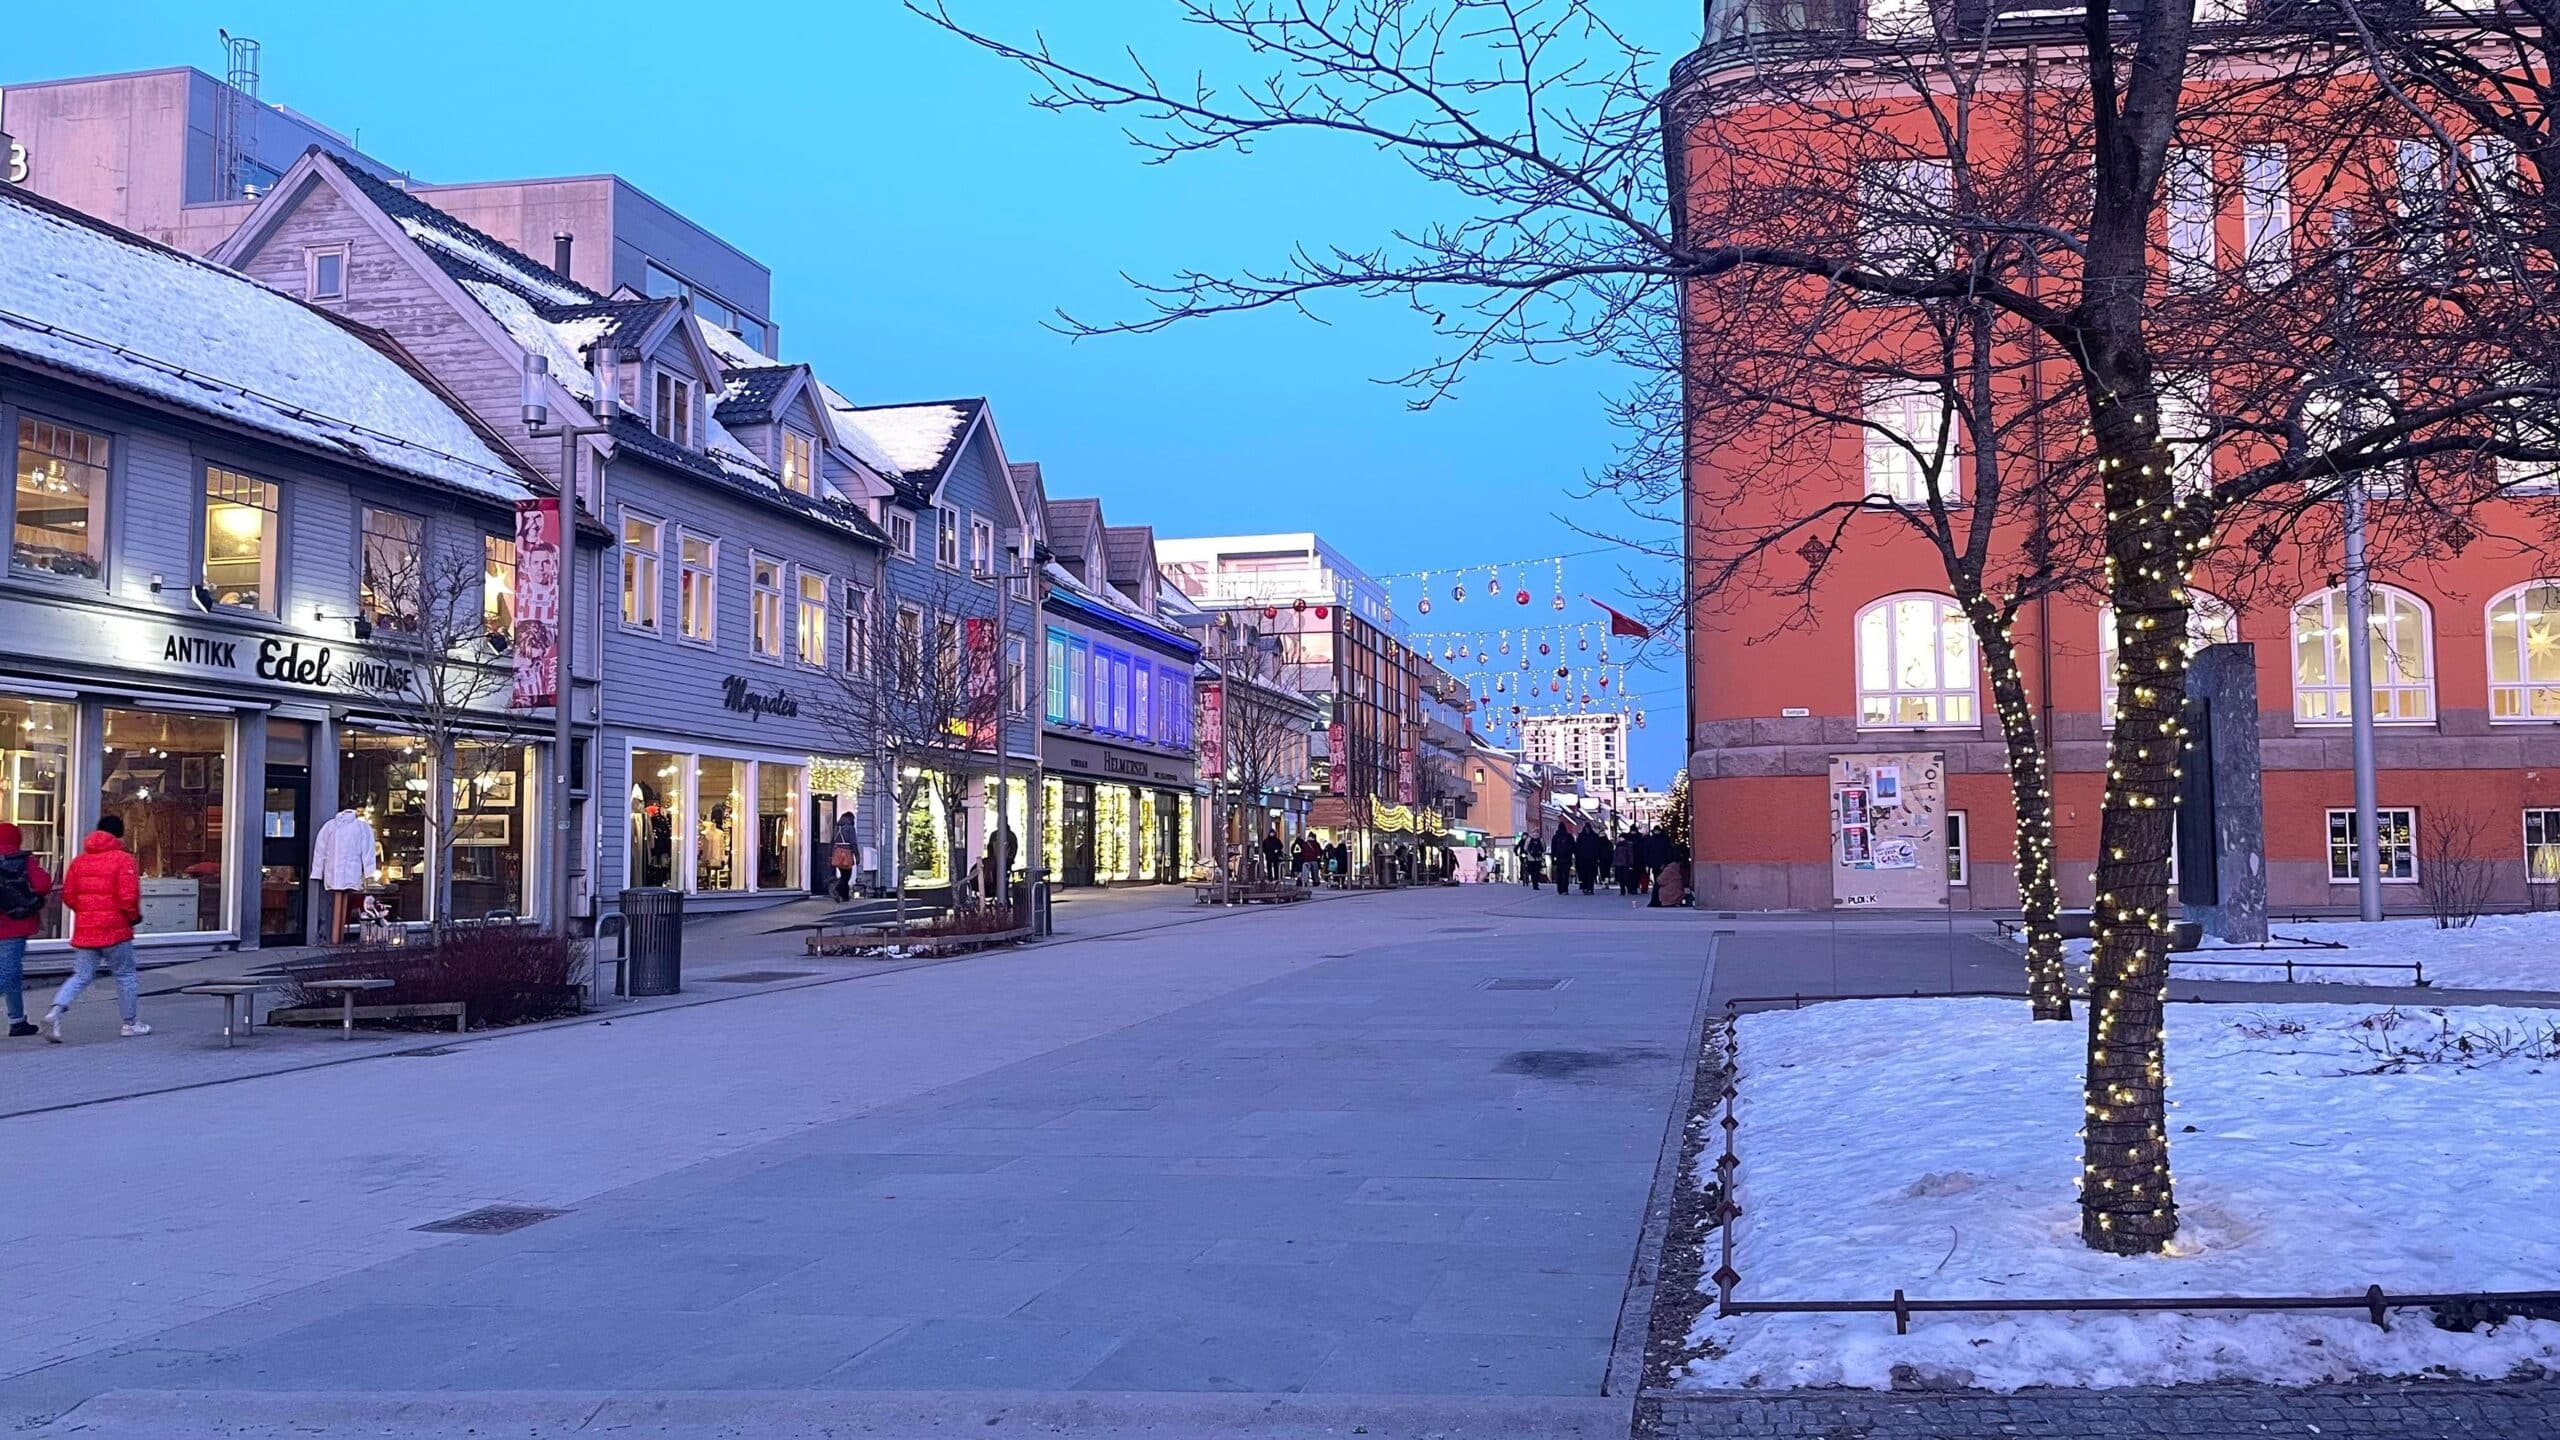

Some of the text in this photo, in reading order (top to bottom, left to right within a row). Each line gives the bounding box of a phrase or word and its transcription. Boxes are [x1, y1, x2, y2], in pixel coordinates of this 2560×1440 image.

[164, 635, 412, 691] ANTIKK Edel VINTAGE
